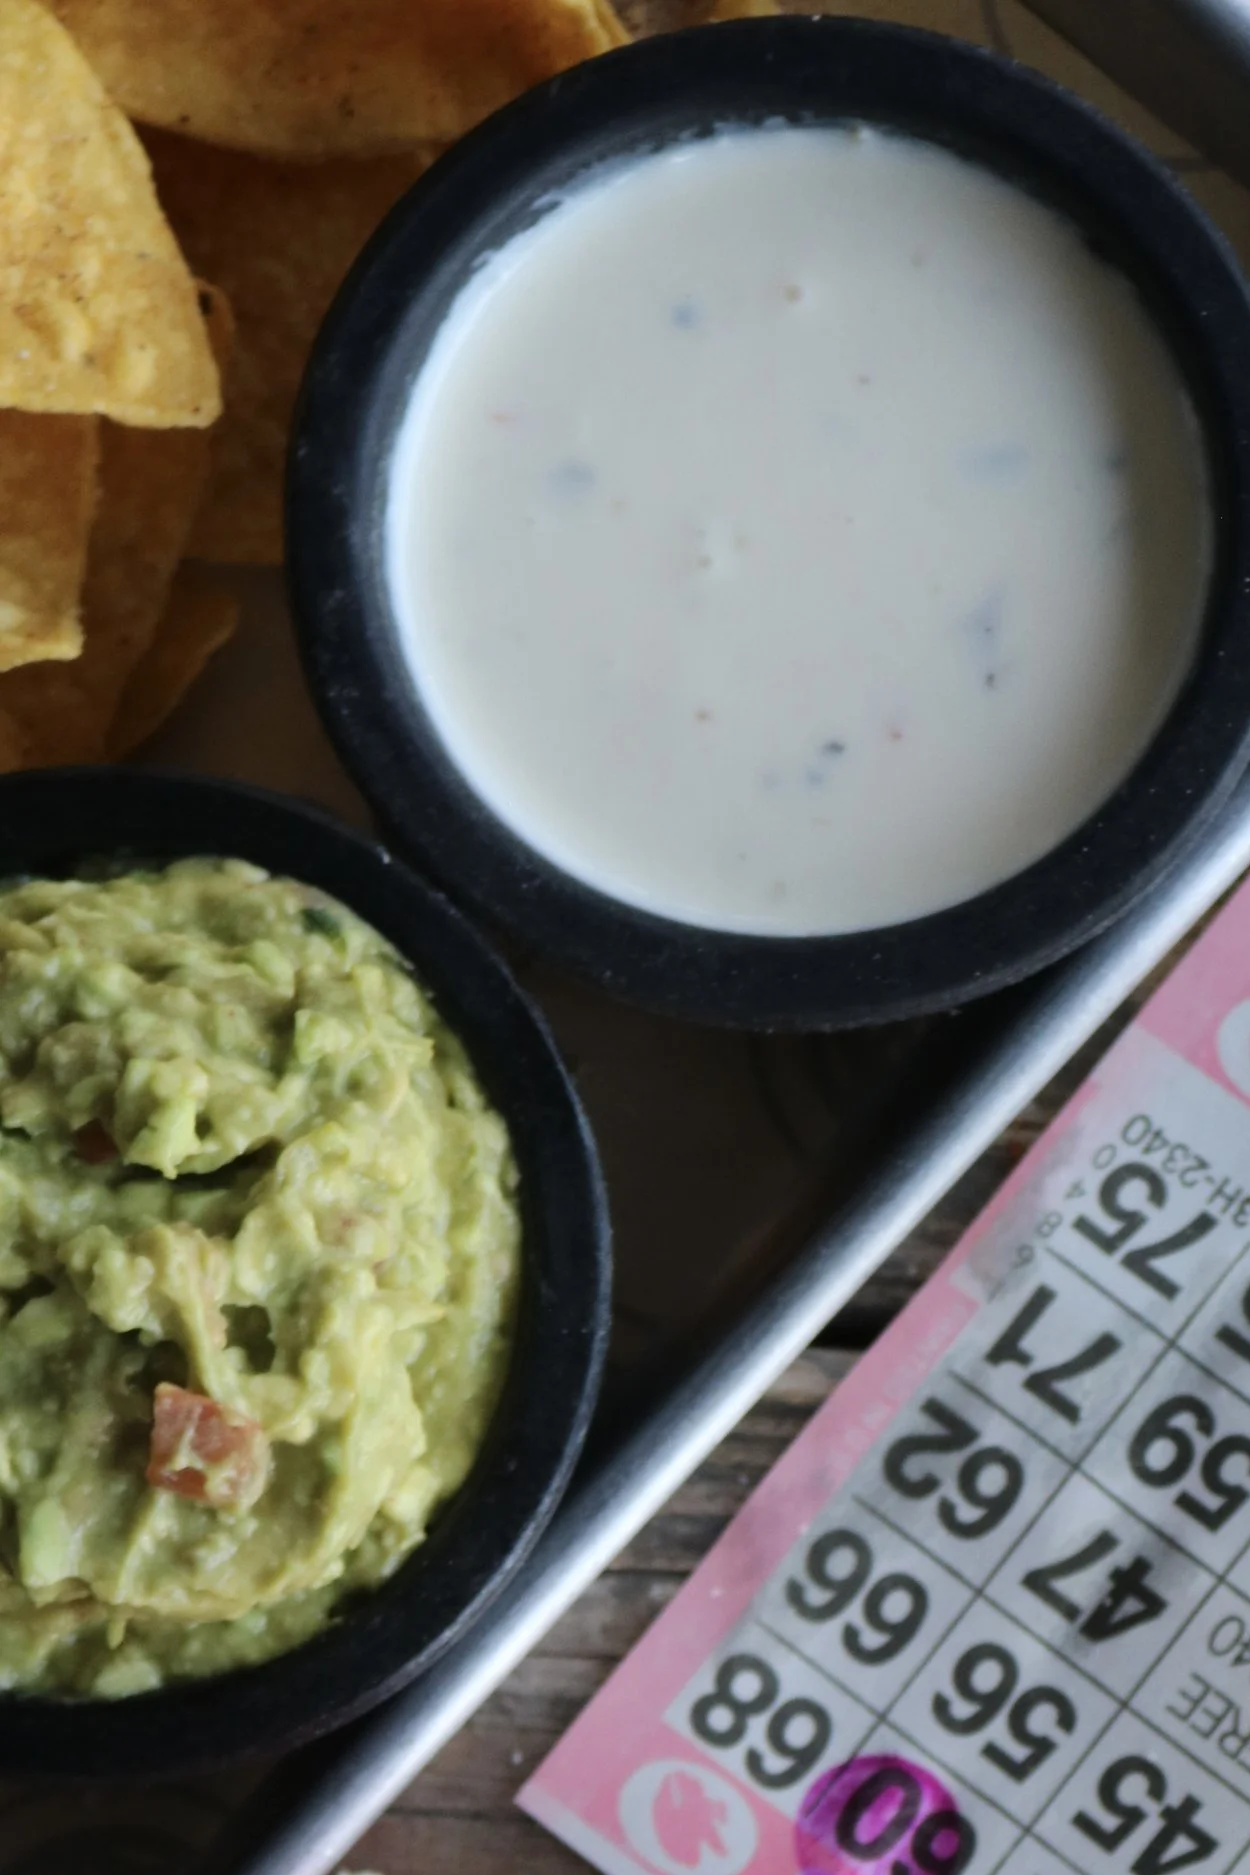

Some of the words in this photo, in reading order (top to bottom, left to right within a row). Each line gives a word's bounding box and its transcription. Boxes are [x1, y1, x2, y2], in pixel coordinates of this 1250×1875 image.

[1076, 1162, 1214, 1297] 75
[986, 1286, 1119, 1422] 71
[883, 1397, 1022, 1538] 62
[788, 1528, 926, 1663] 66
[1022, 1530, 1166, 1642] 47
[689, 1650, 832, 1790] 68
[931, 1640, 1077, 1783] 56
